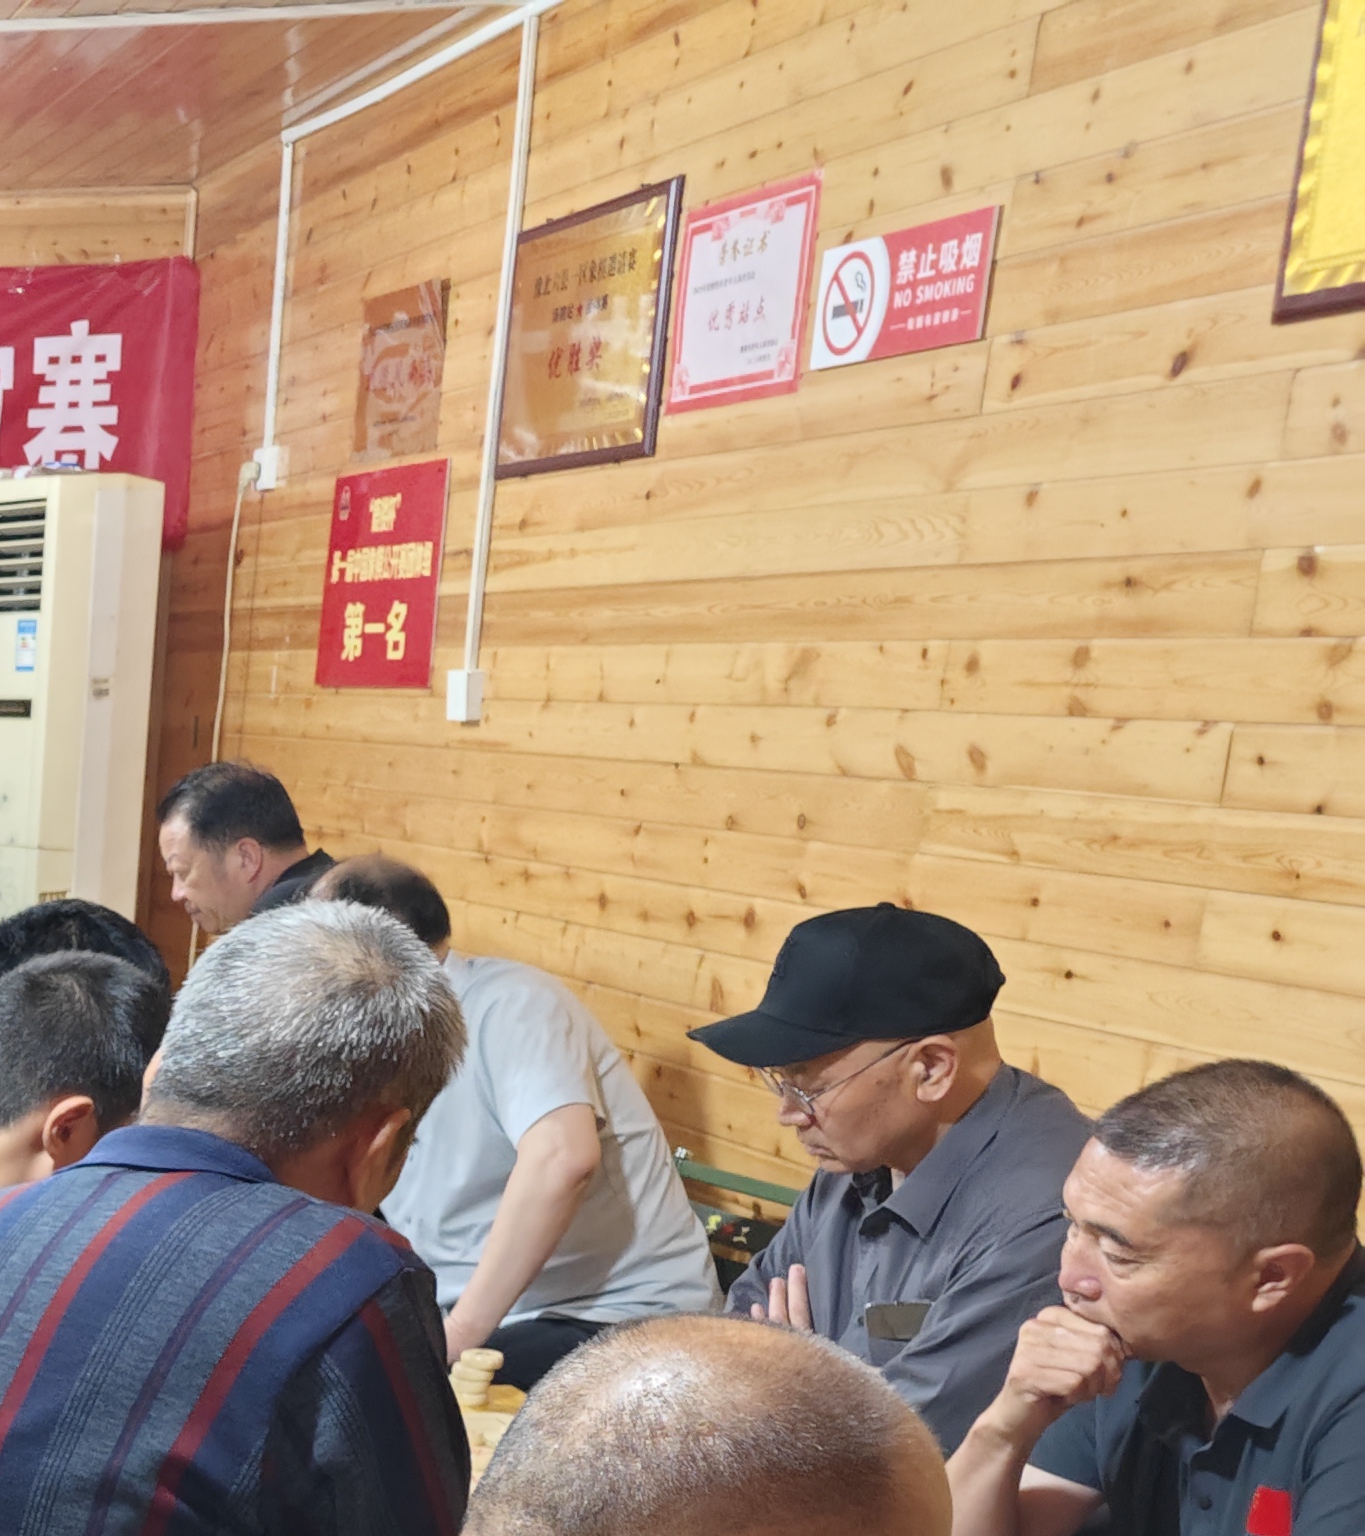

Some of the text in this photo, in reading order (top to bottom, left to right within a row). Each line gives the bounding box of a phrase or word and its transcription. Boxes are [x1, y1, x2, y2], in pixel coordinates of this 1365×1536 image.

[896, 232, 983, 285] 禁止吸烟
[893, 274, 975, 309] NO SMOKING
[340, 600, 408, 662] 第一名
